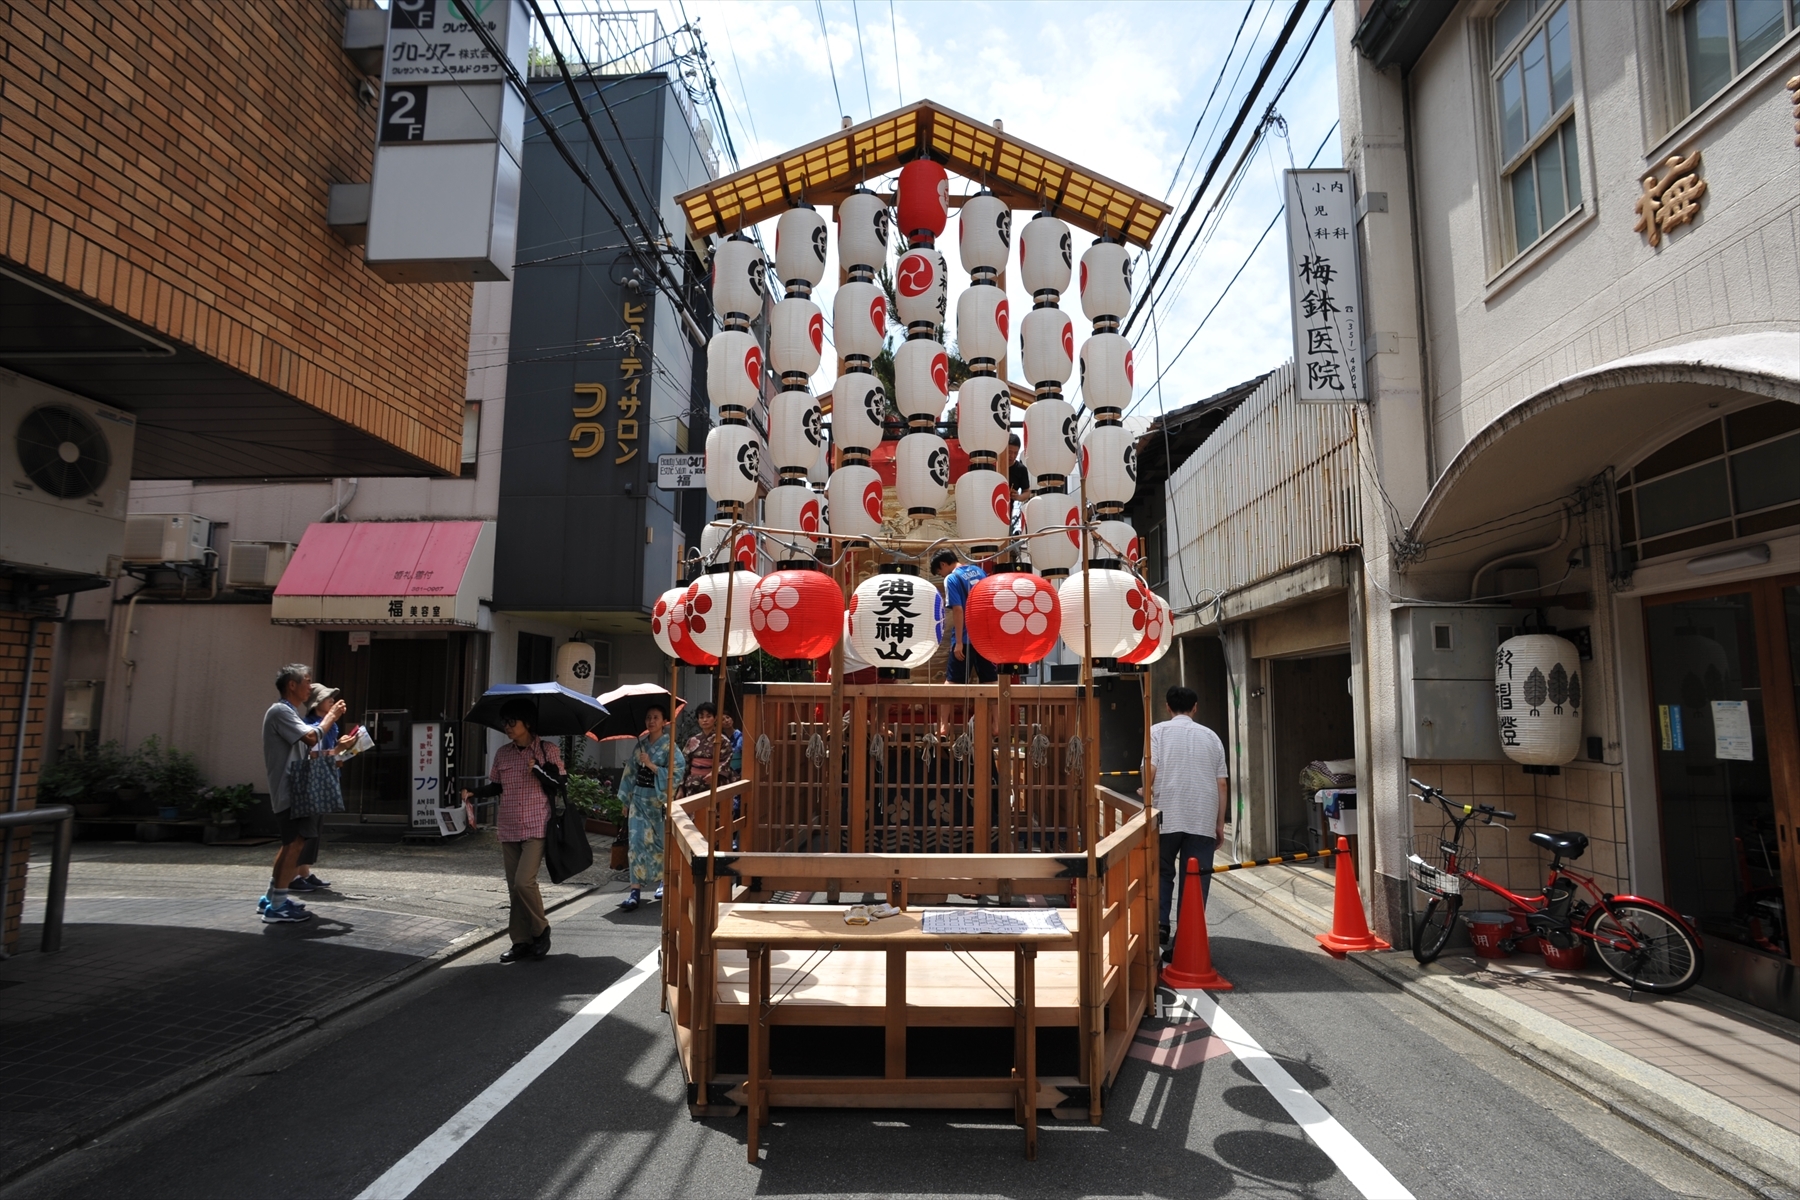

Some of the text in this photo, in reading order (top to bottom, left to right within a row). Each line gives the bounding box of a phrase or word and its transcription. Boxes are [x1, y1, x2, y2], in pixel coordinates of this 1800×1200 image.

[392, 42, 497, 62] グローリアー 株式会
[389, 91, 422, 140] 2F
[1330, 181, 1349, 241] 内科
[1298, 254, 1346, 391] 梅鉢医院
[568, 381, 608, 459] フク
[676, 474, 692, 487] 福
[387, 599, 441, 618] 福 美容室
[871, 577, 922, 662] 油天神山
[413, 776, 438, 791] フク
